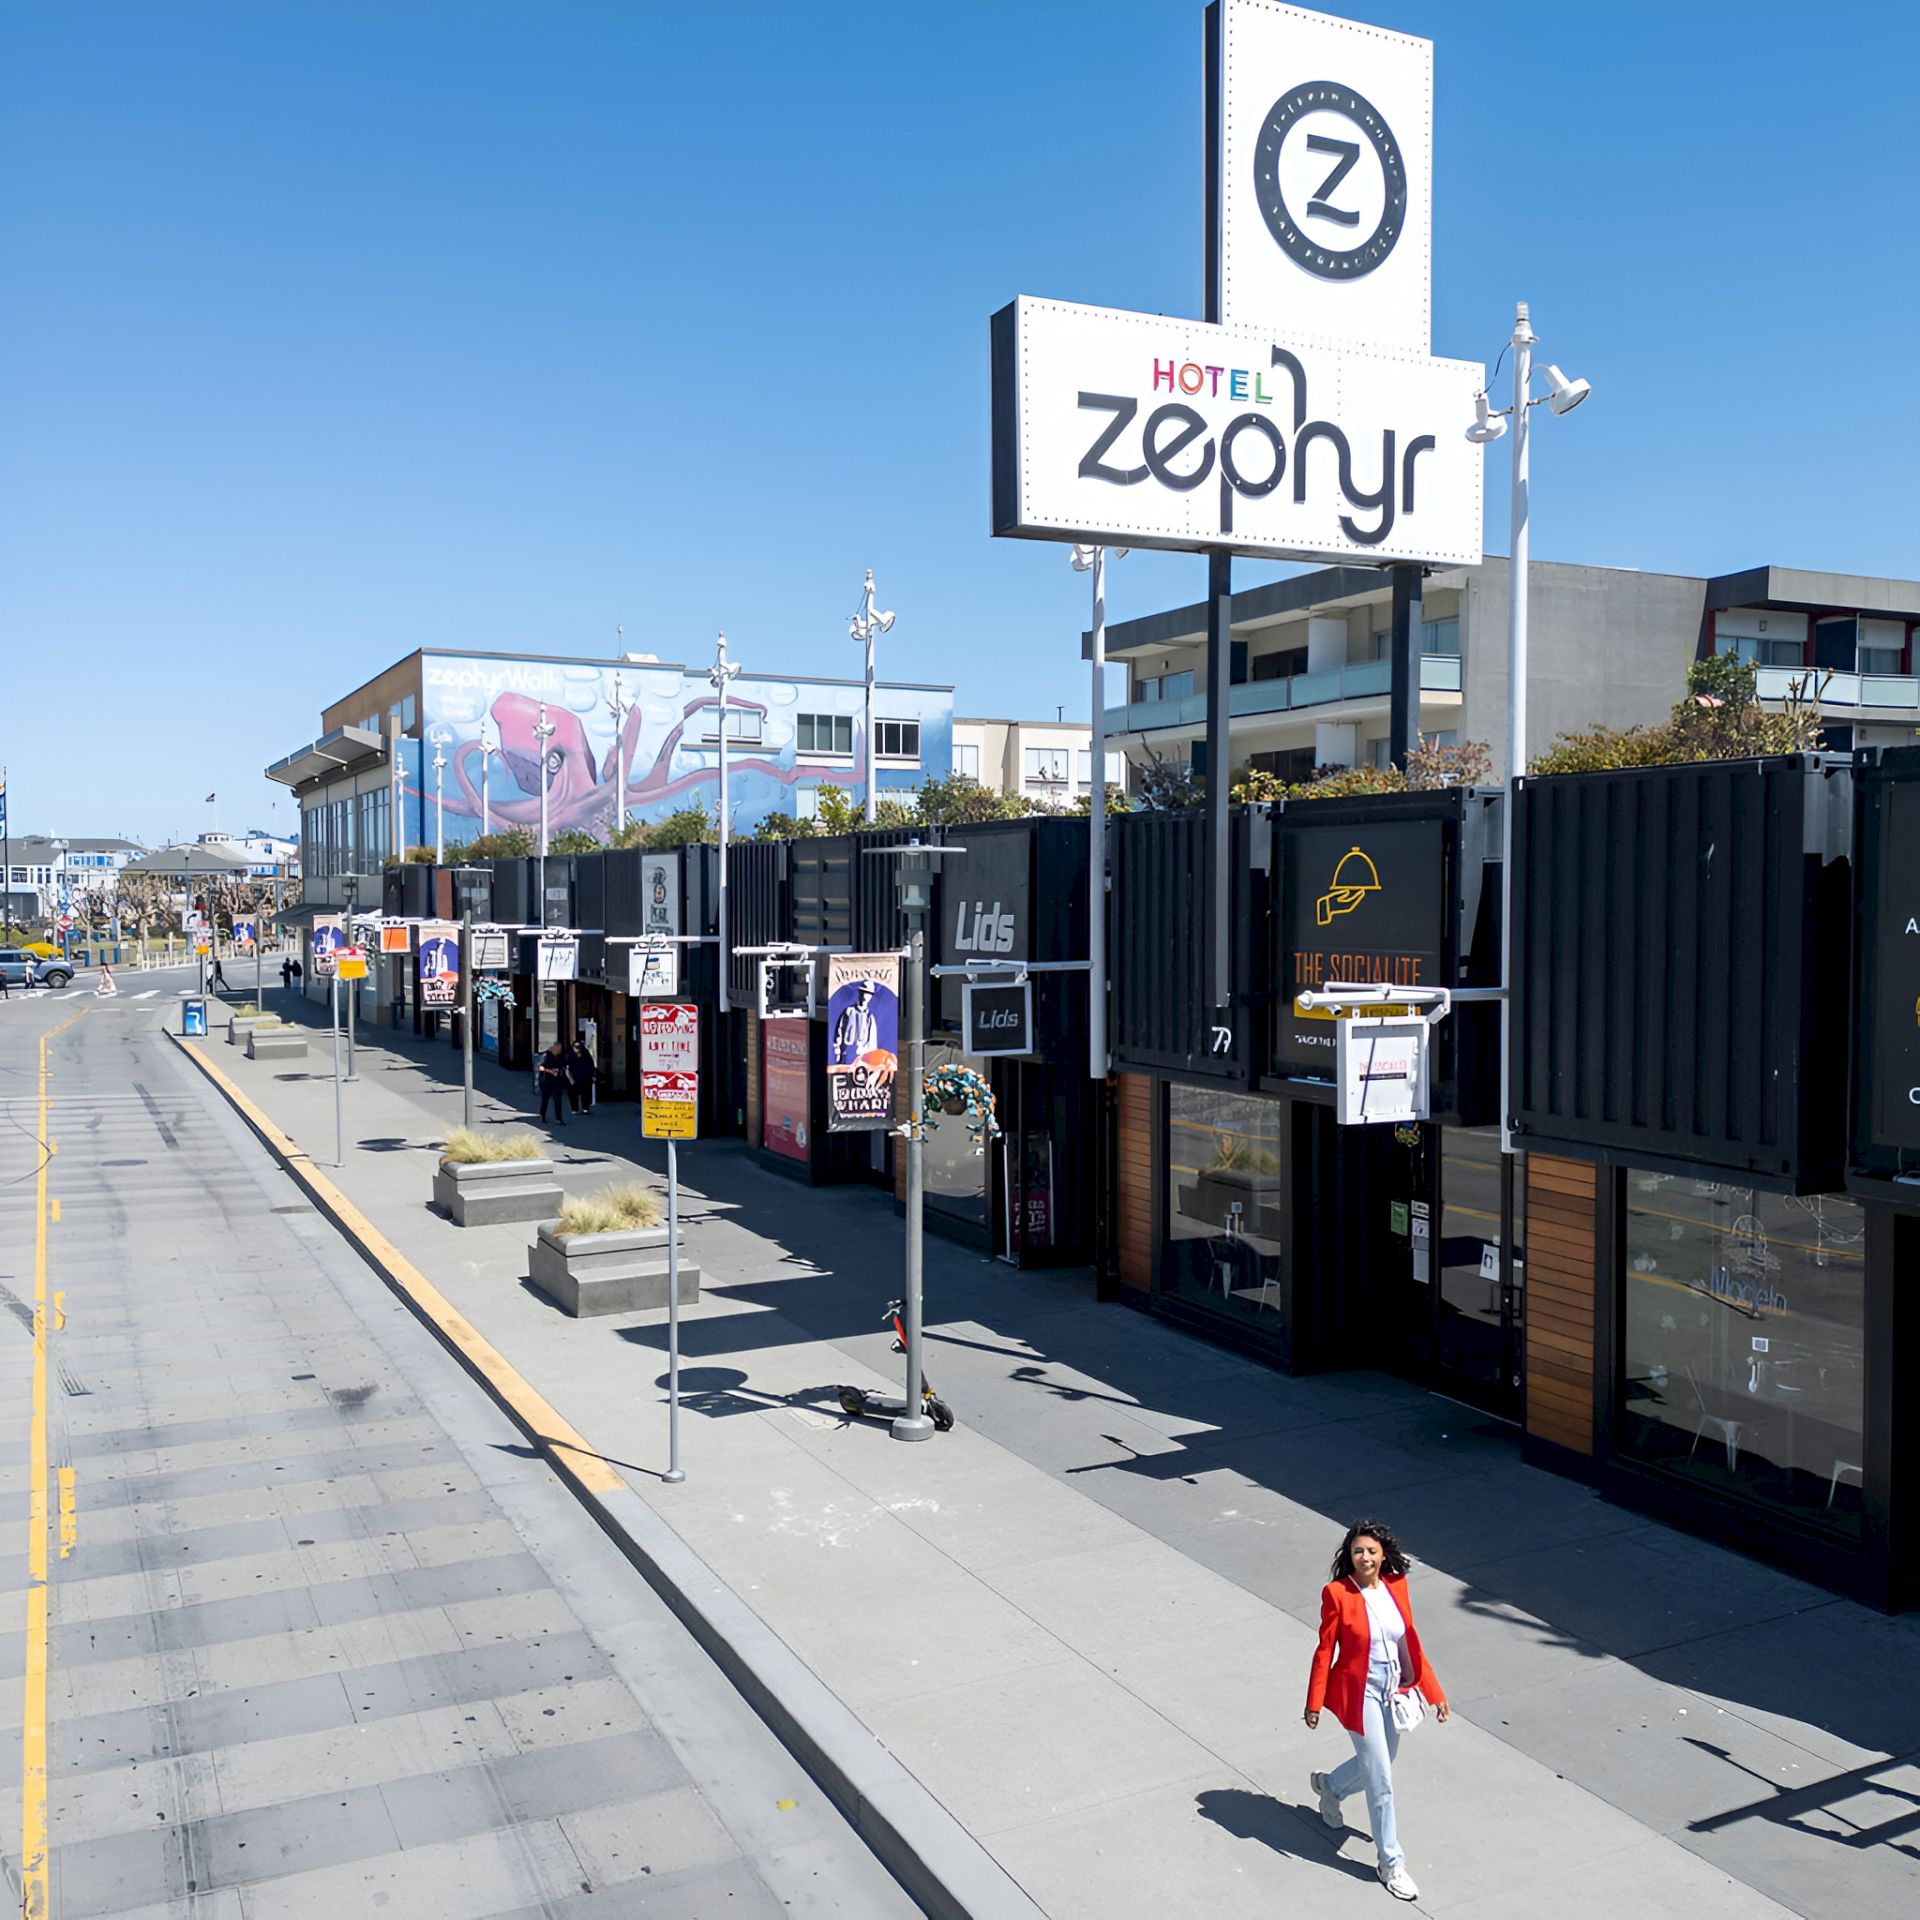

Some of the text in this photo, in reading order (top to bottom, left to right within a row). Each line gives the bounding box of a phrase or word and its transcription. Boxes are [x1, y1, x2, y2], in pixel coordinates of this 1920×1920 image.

[1306, 134, 1360, 227] Z
[1153, 358, 1273, 404] HOTEL
[1077, 345, 1436, 546] zephyr
[955, 901, 1015, 953] Lids
[1294, 951, 1422, 987] THE SOCIALITE
[978, 1009, 1018, 1029] Lids
